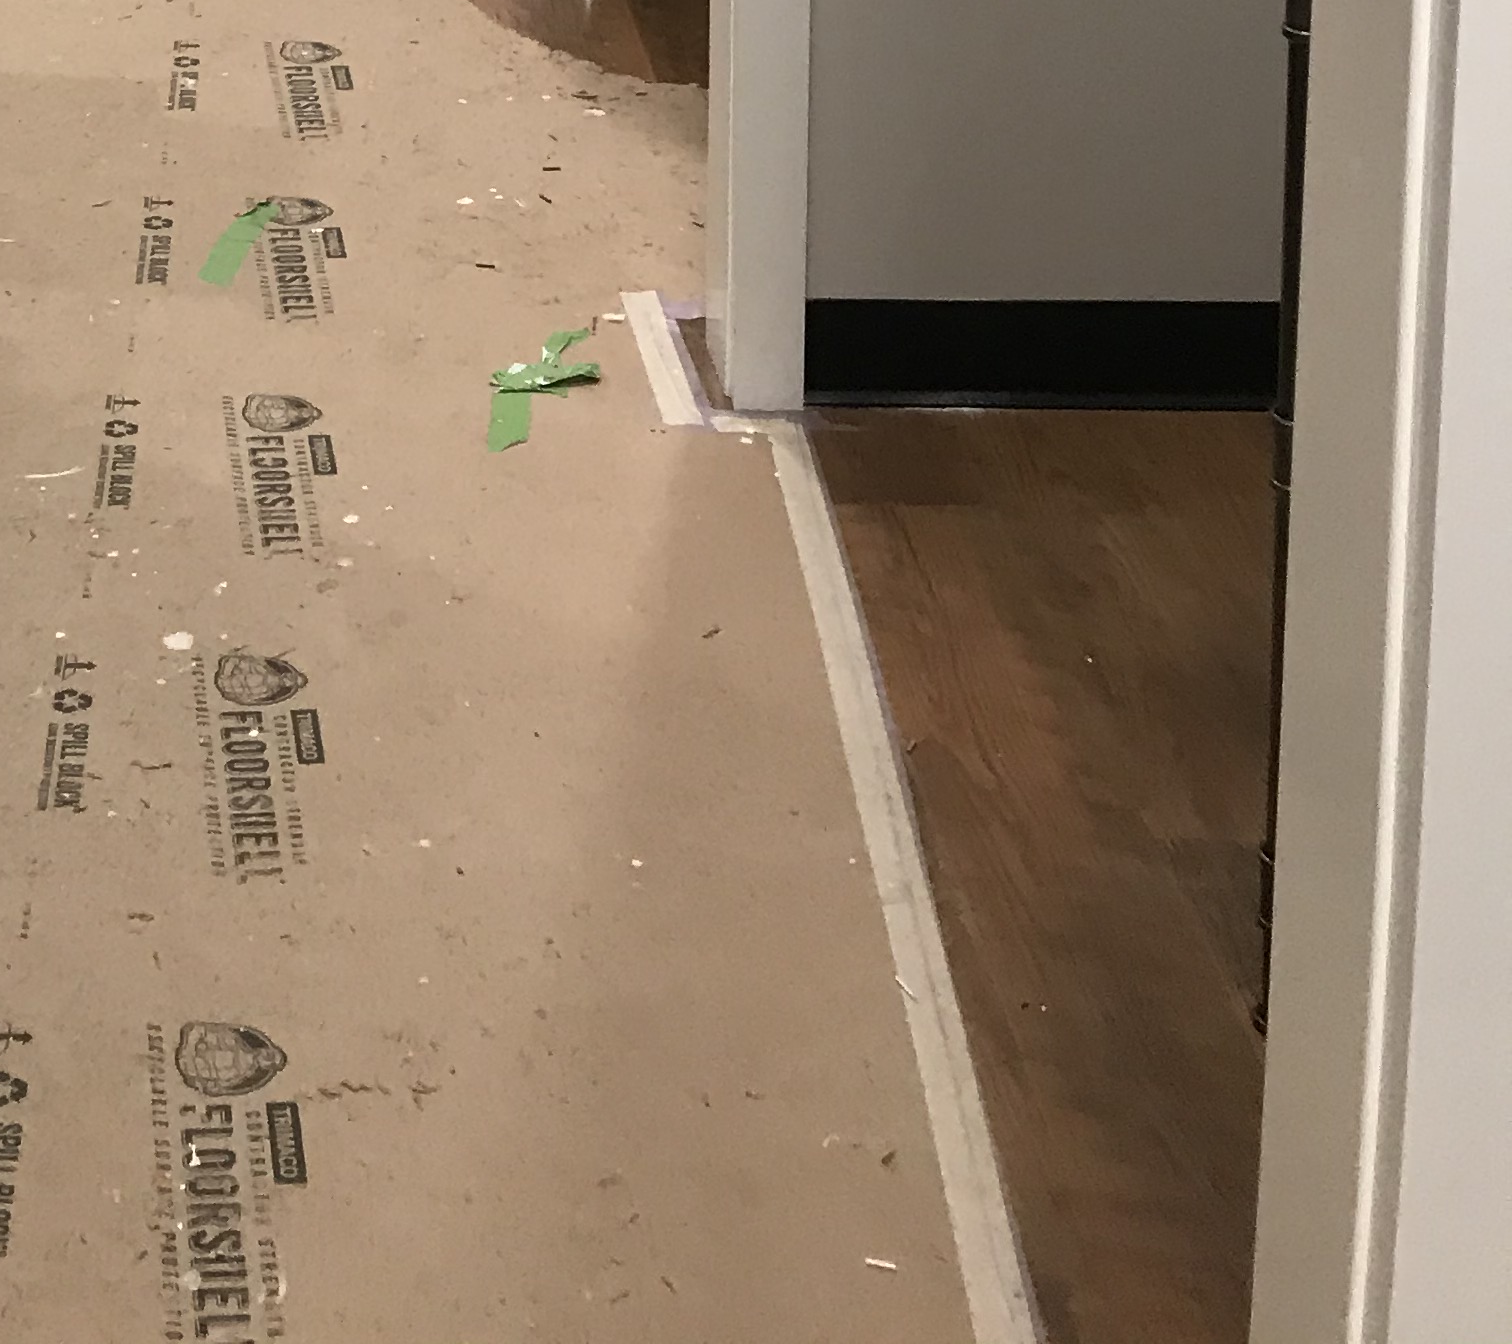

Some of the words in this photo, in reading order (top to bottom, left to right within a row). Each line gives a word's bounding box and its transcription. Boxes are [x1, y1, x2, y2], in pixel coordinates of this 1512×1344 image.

[267, 228, 317, 323] FLOORSHELL
[112, 444, 137, 472] SPILL
[245, 435, 304, 561] FLOORSHELL
[60, 723, 90, 760] SPILL
[53, 763, 85, 808] BLOCK
[219, 711, 284, 886] FLOORSHELL
[273, 1111, 299, 1179] TRIMACO
[179, 1104, 255, 1344] FLOORSHEL
